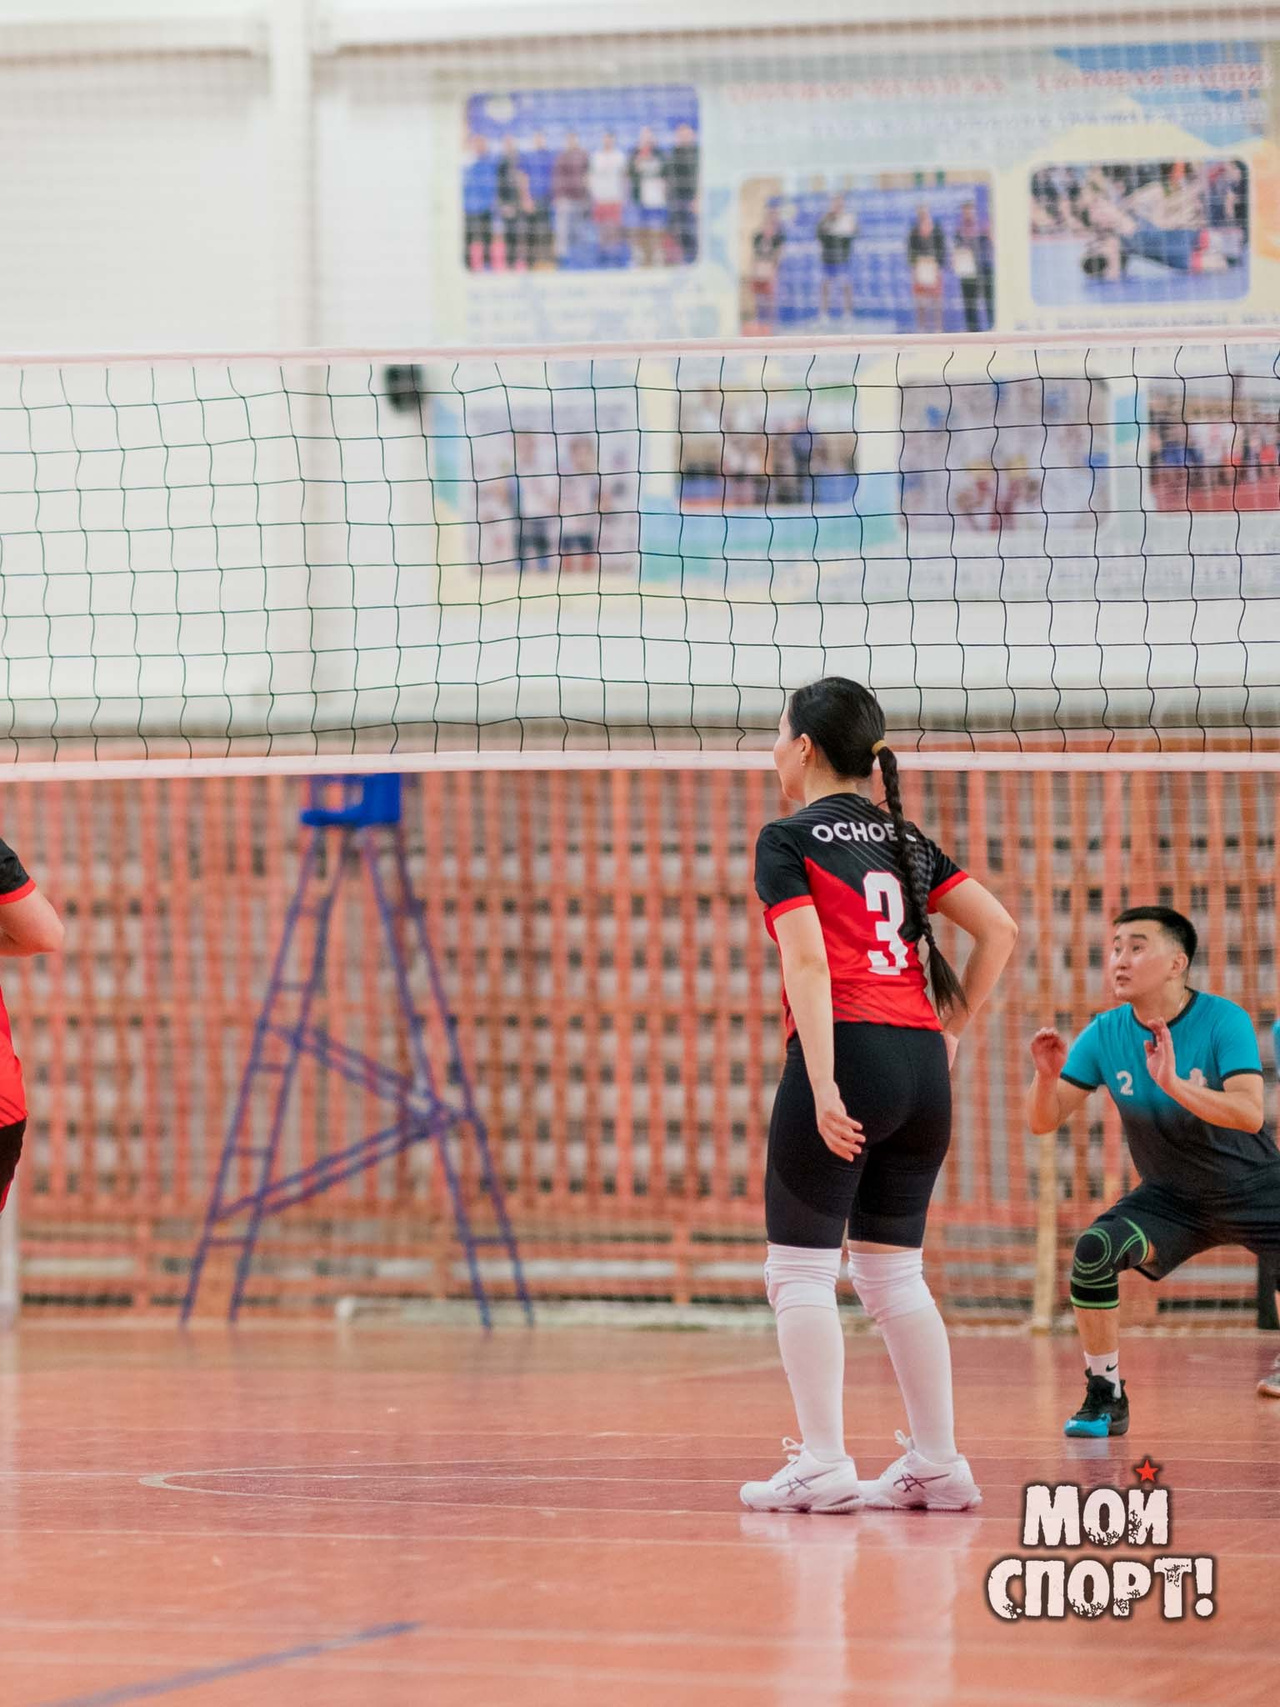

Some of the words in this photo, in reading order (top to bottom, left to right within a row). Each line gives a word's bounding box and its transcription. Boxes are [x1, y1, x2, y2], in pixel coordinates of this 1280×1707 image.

[811, 821, 917, 843] ОСНОВ
[863, 871, 908, 976] 3
[1116, 1070, 1134, 1096] 2
